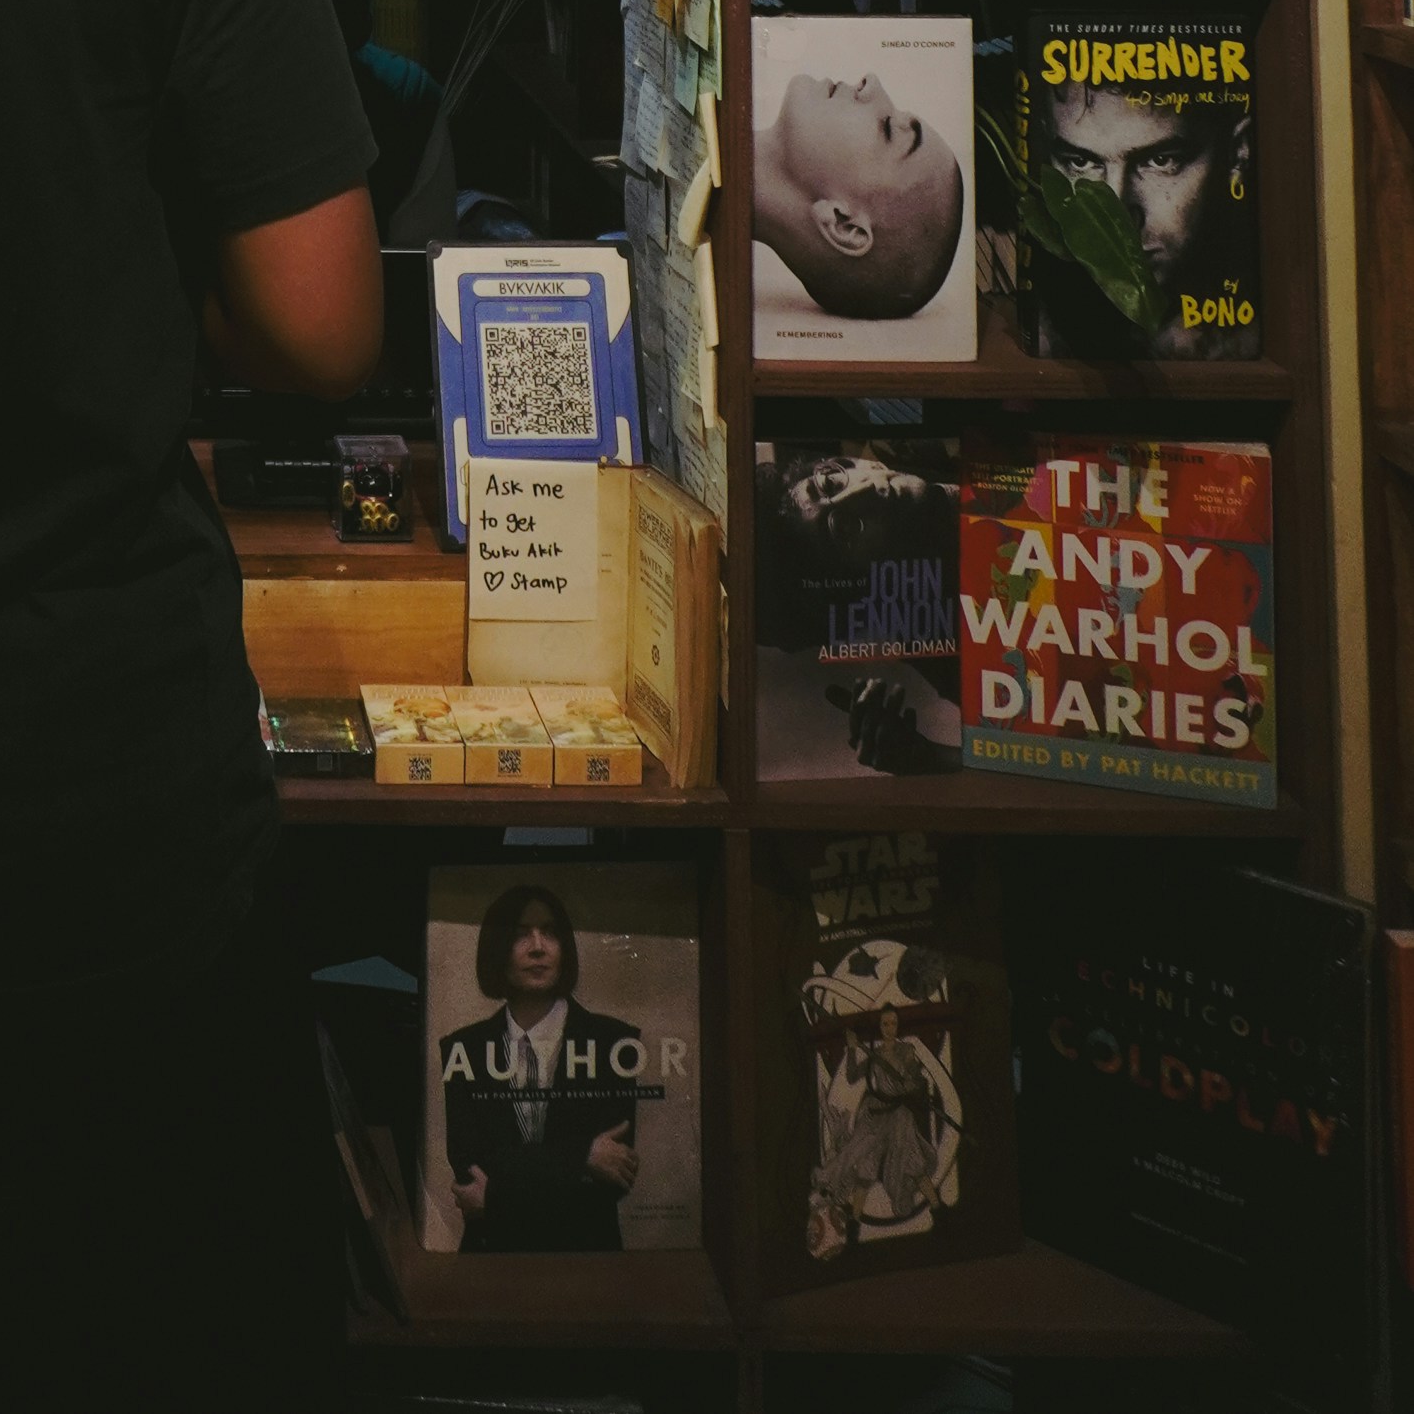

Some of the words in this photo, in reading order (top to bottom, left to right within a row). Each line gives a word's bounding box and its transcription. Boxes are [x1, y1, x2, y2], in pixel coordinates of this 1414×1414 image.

[912, 40, 957, 49] O'CONNOR
[1049, 23, 1070, 34] THE
[1076, 23, 1123, 34] SUNDAY
[1128, 23, 1165, 34] TIMES
[1169, 23, 1244, 34] BESTSELLER
[1040, 35, 1251, 86] SURRENDER
[1124, 90, 1152, 109] 40
[1180, 292, 1257, 330] BONO
[775, 330, 845, 341] REMEMBERINGS
[485, 473, 525, 498] Ask
[532, 480, 567, 500] me
[1045, 458, 1170, 519] THE
[480, 511, 500, 531] to
[506, 513, 538, 534] get
[479, 542, 521, 561] Buku
[527, 540, 564, 559] Akik
[1008, 527, 1214, 596] ANDY
[509, 571, 570, 594] Stamp
[801, 578, 822, 590] The
[823, 577, 854, 590] Lives
[868, 557, 943, 606] JOHN
[827, 597, 956, 645] LENNON
[960, 592, 1269, 678] WARHOL
[818, 642, 879, 662] ALBERT
[881, 637, 957, 658] GOLDMAN
[980, 668, 1251, 750] DIARIES
[971, 738, 1052, 765] EDITED
[1059, 747, 1091, 772] BY
[1099, 755, 1144, 778] PAT
[1151, 762, 1262, 792] HACKETT
[810, 829, 939, 882] STAR
[810, 875, 940, 928] WARS
[1140, 954, 1196, 986] LIFE
[441, 1036, 689, 1083] AUTHOR
[1047, 1014, 1341, 1158] COLDPLAY
